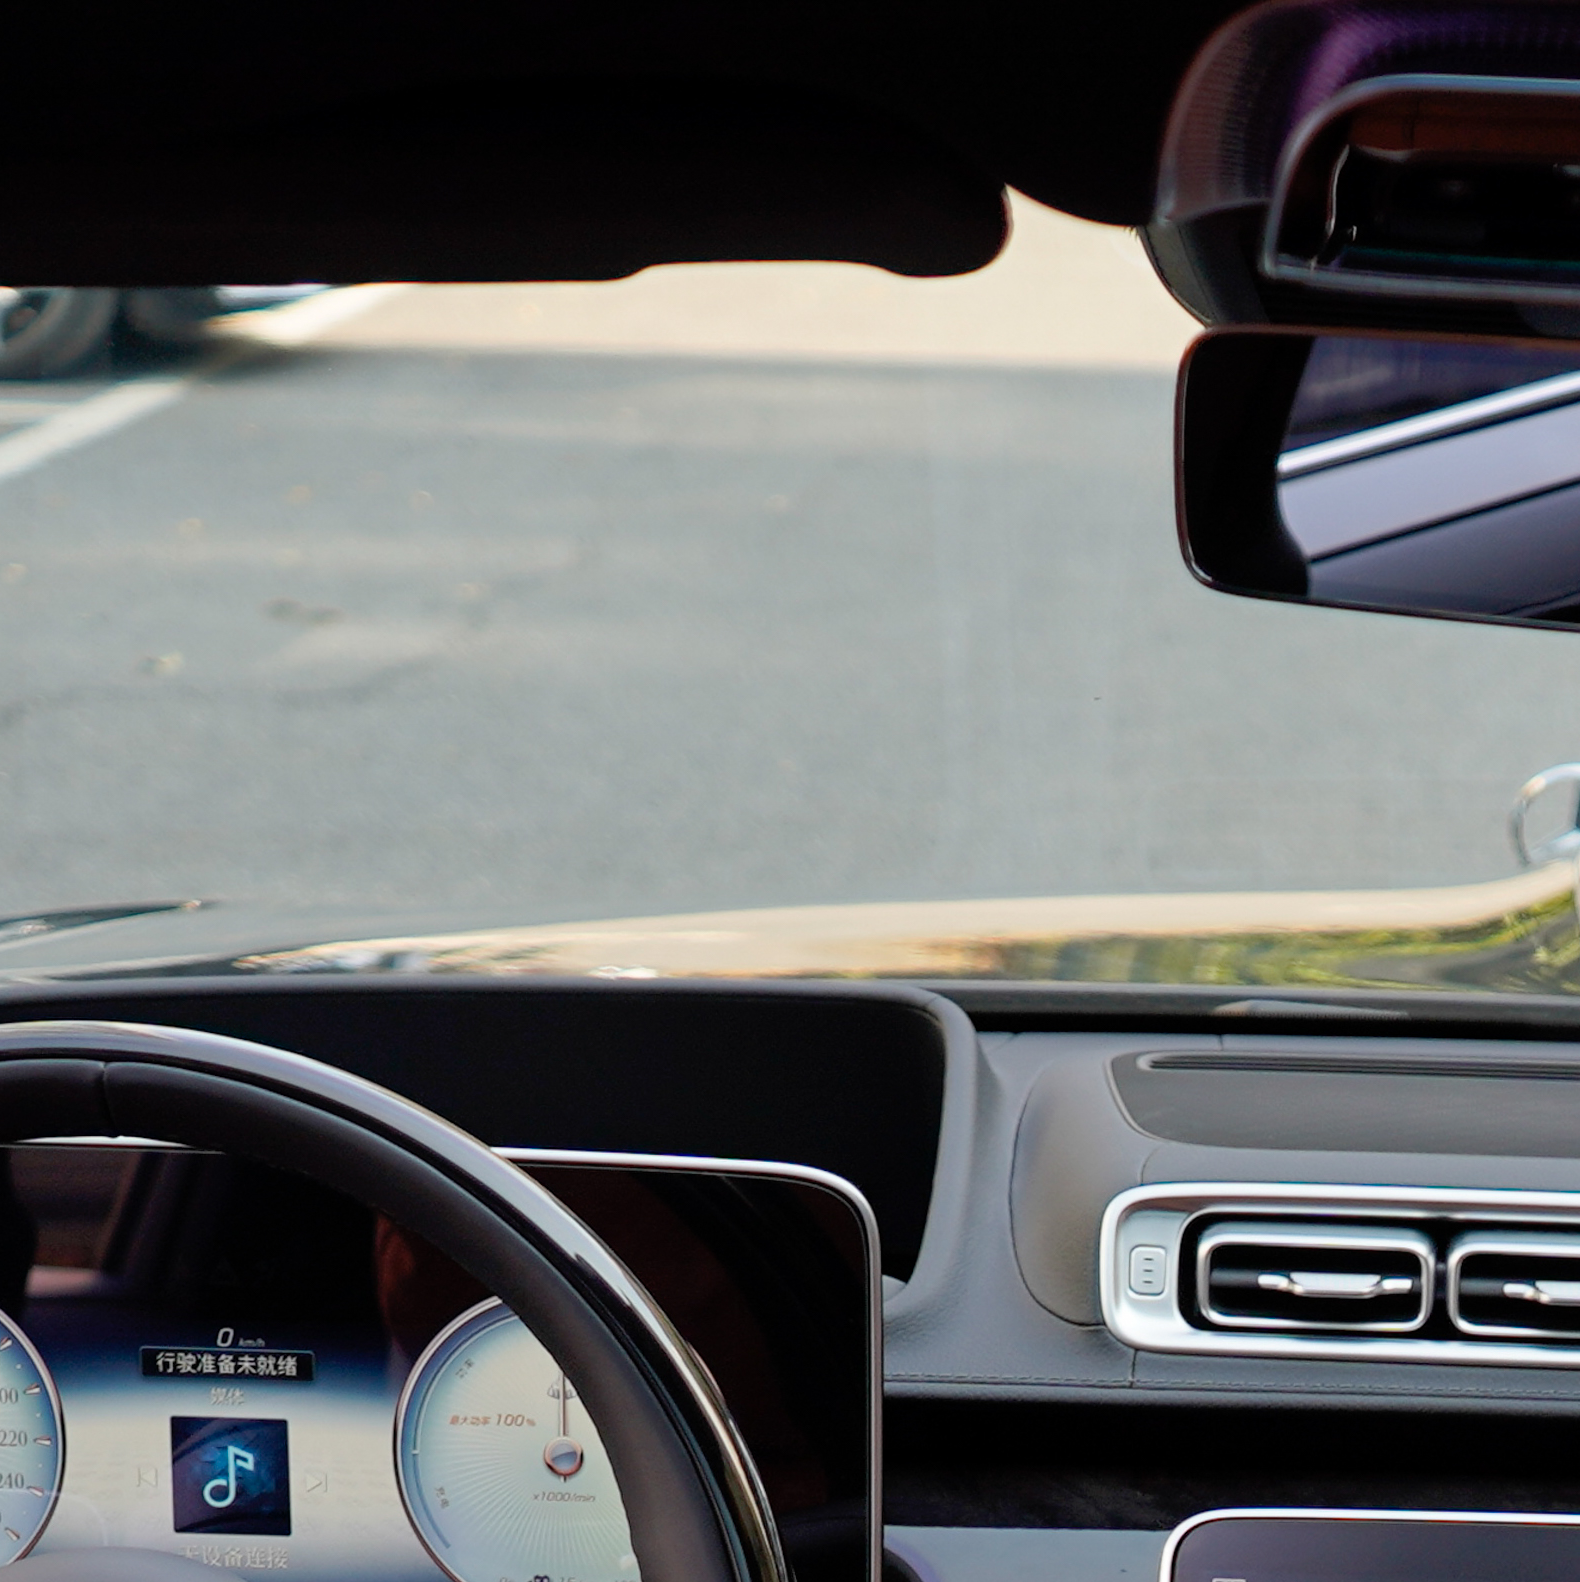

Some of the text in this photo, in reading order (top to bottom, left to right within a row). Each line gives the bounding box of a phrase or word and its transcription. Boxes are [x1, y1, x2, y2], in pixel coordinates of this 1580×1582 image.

[216, 1327, 234, 1348] 0
[156, 1352, 298, 1376] 行驶准备未就绪
